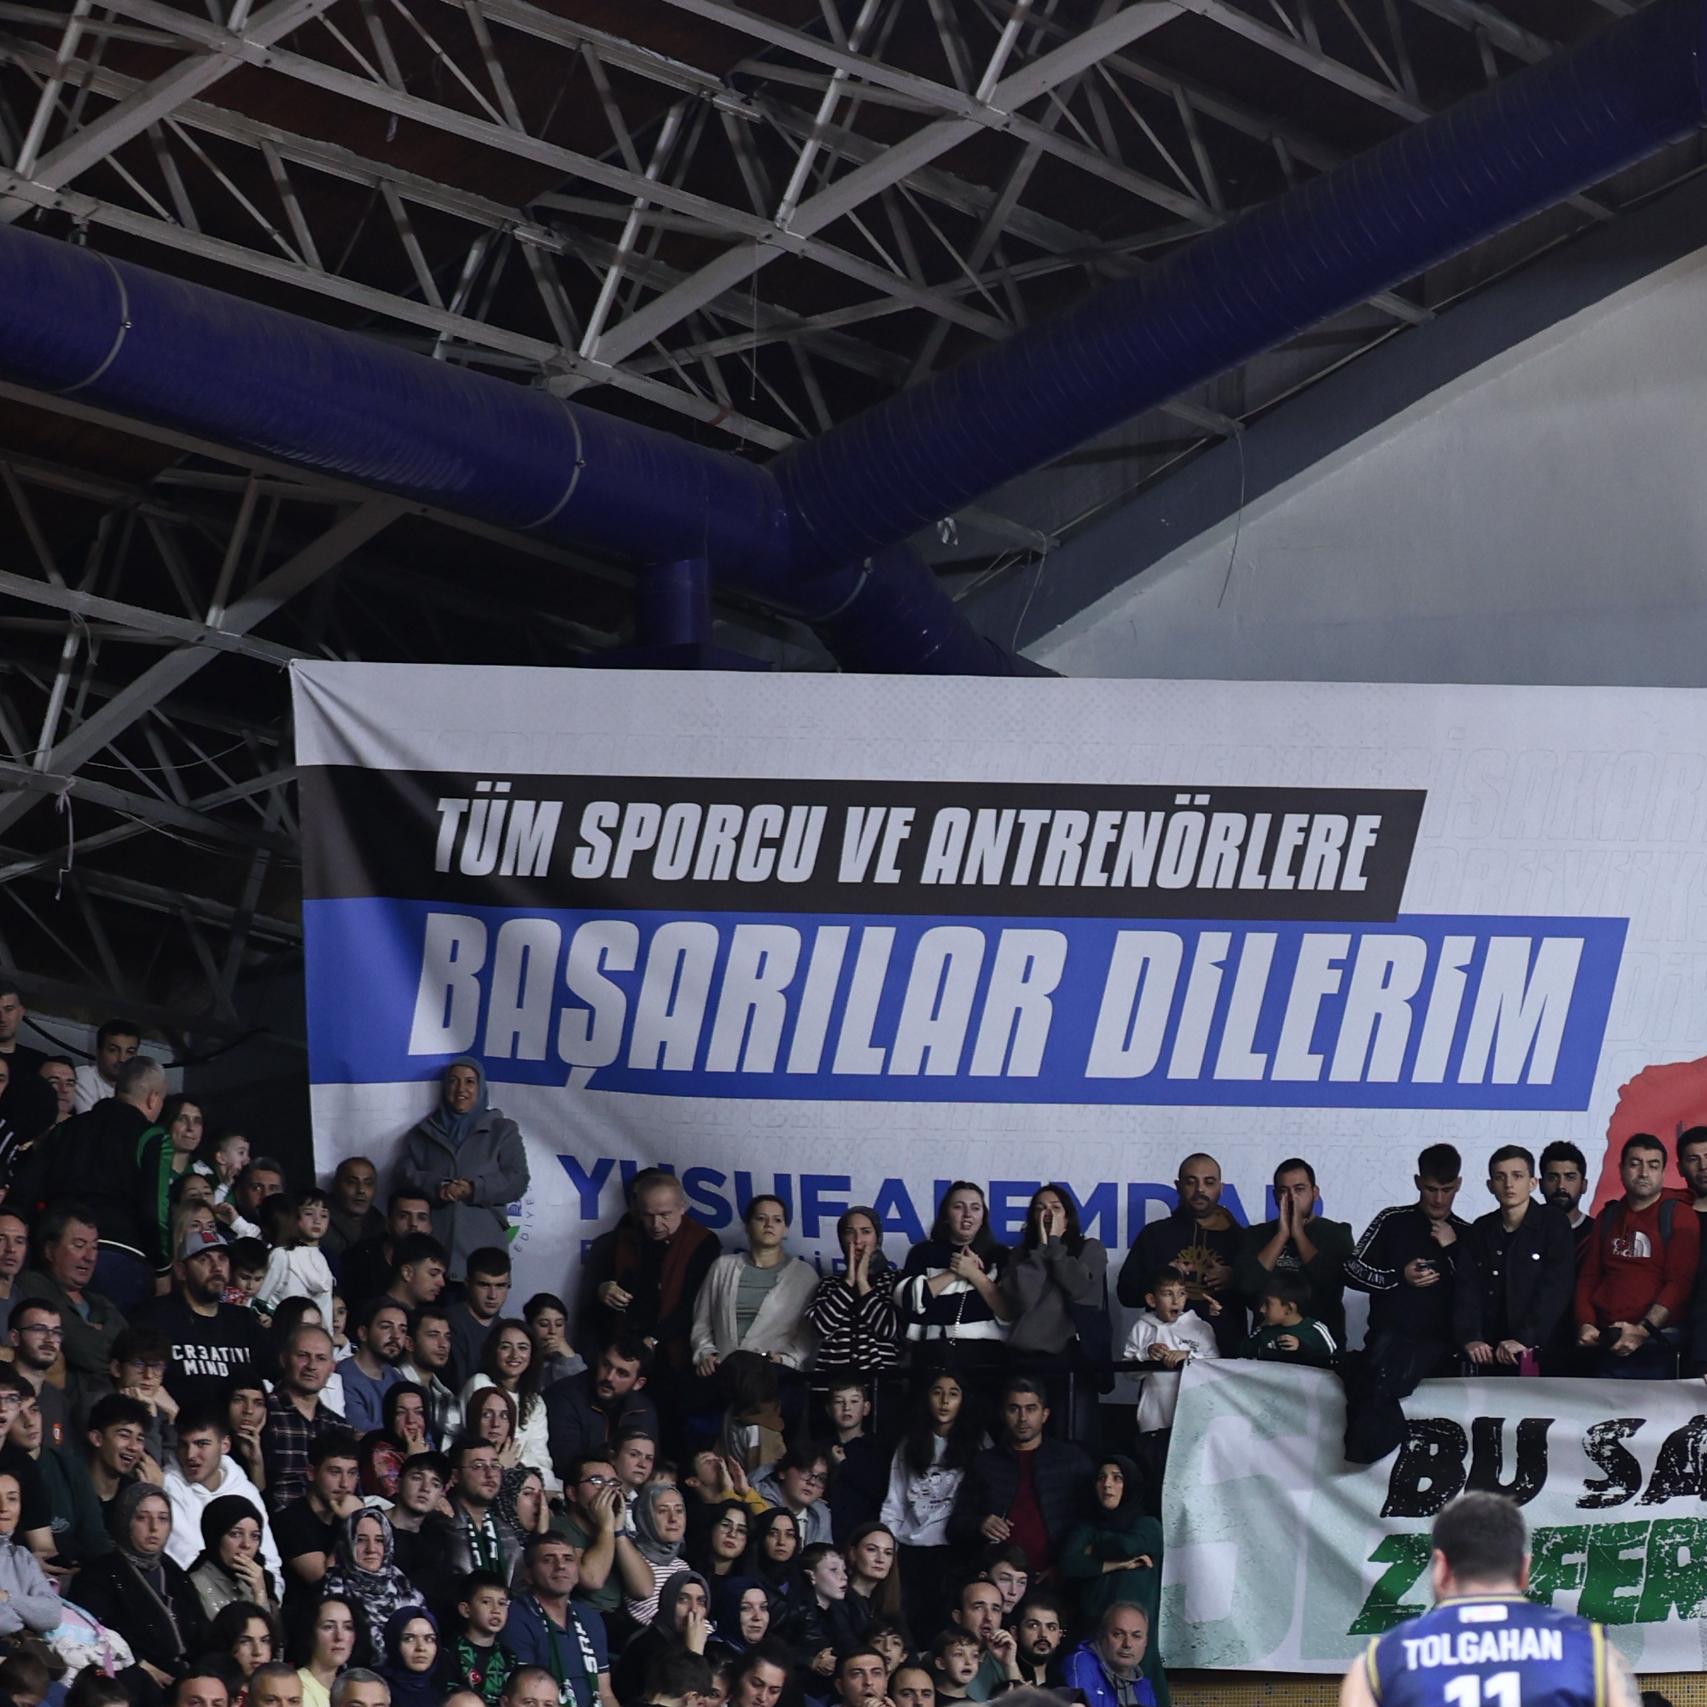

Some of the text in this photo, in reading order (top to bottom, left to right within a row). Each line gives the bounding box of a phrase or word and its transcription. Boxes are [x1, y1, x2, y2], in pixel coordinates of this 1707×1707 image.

[434, 781, 563, 878] TÜM
[573, 799, 826, 886] SPORCU
[838, 805, 915, 885] VE
[920, 792, 1382, 894] ANTRENÖRLERE
[406, 911, 1585, 1092] BAŞARILAR DİLERİM
[183, 1359, 229, 1377] MIND
[1381, 1416, 1555, 1517] BU
[1402, 1627, 1563, 1671] TOLGAHAN
